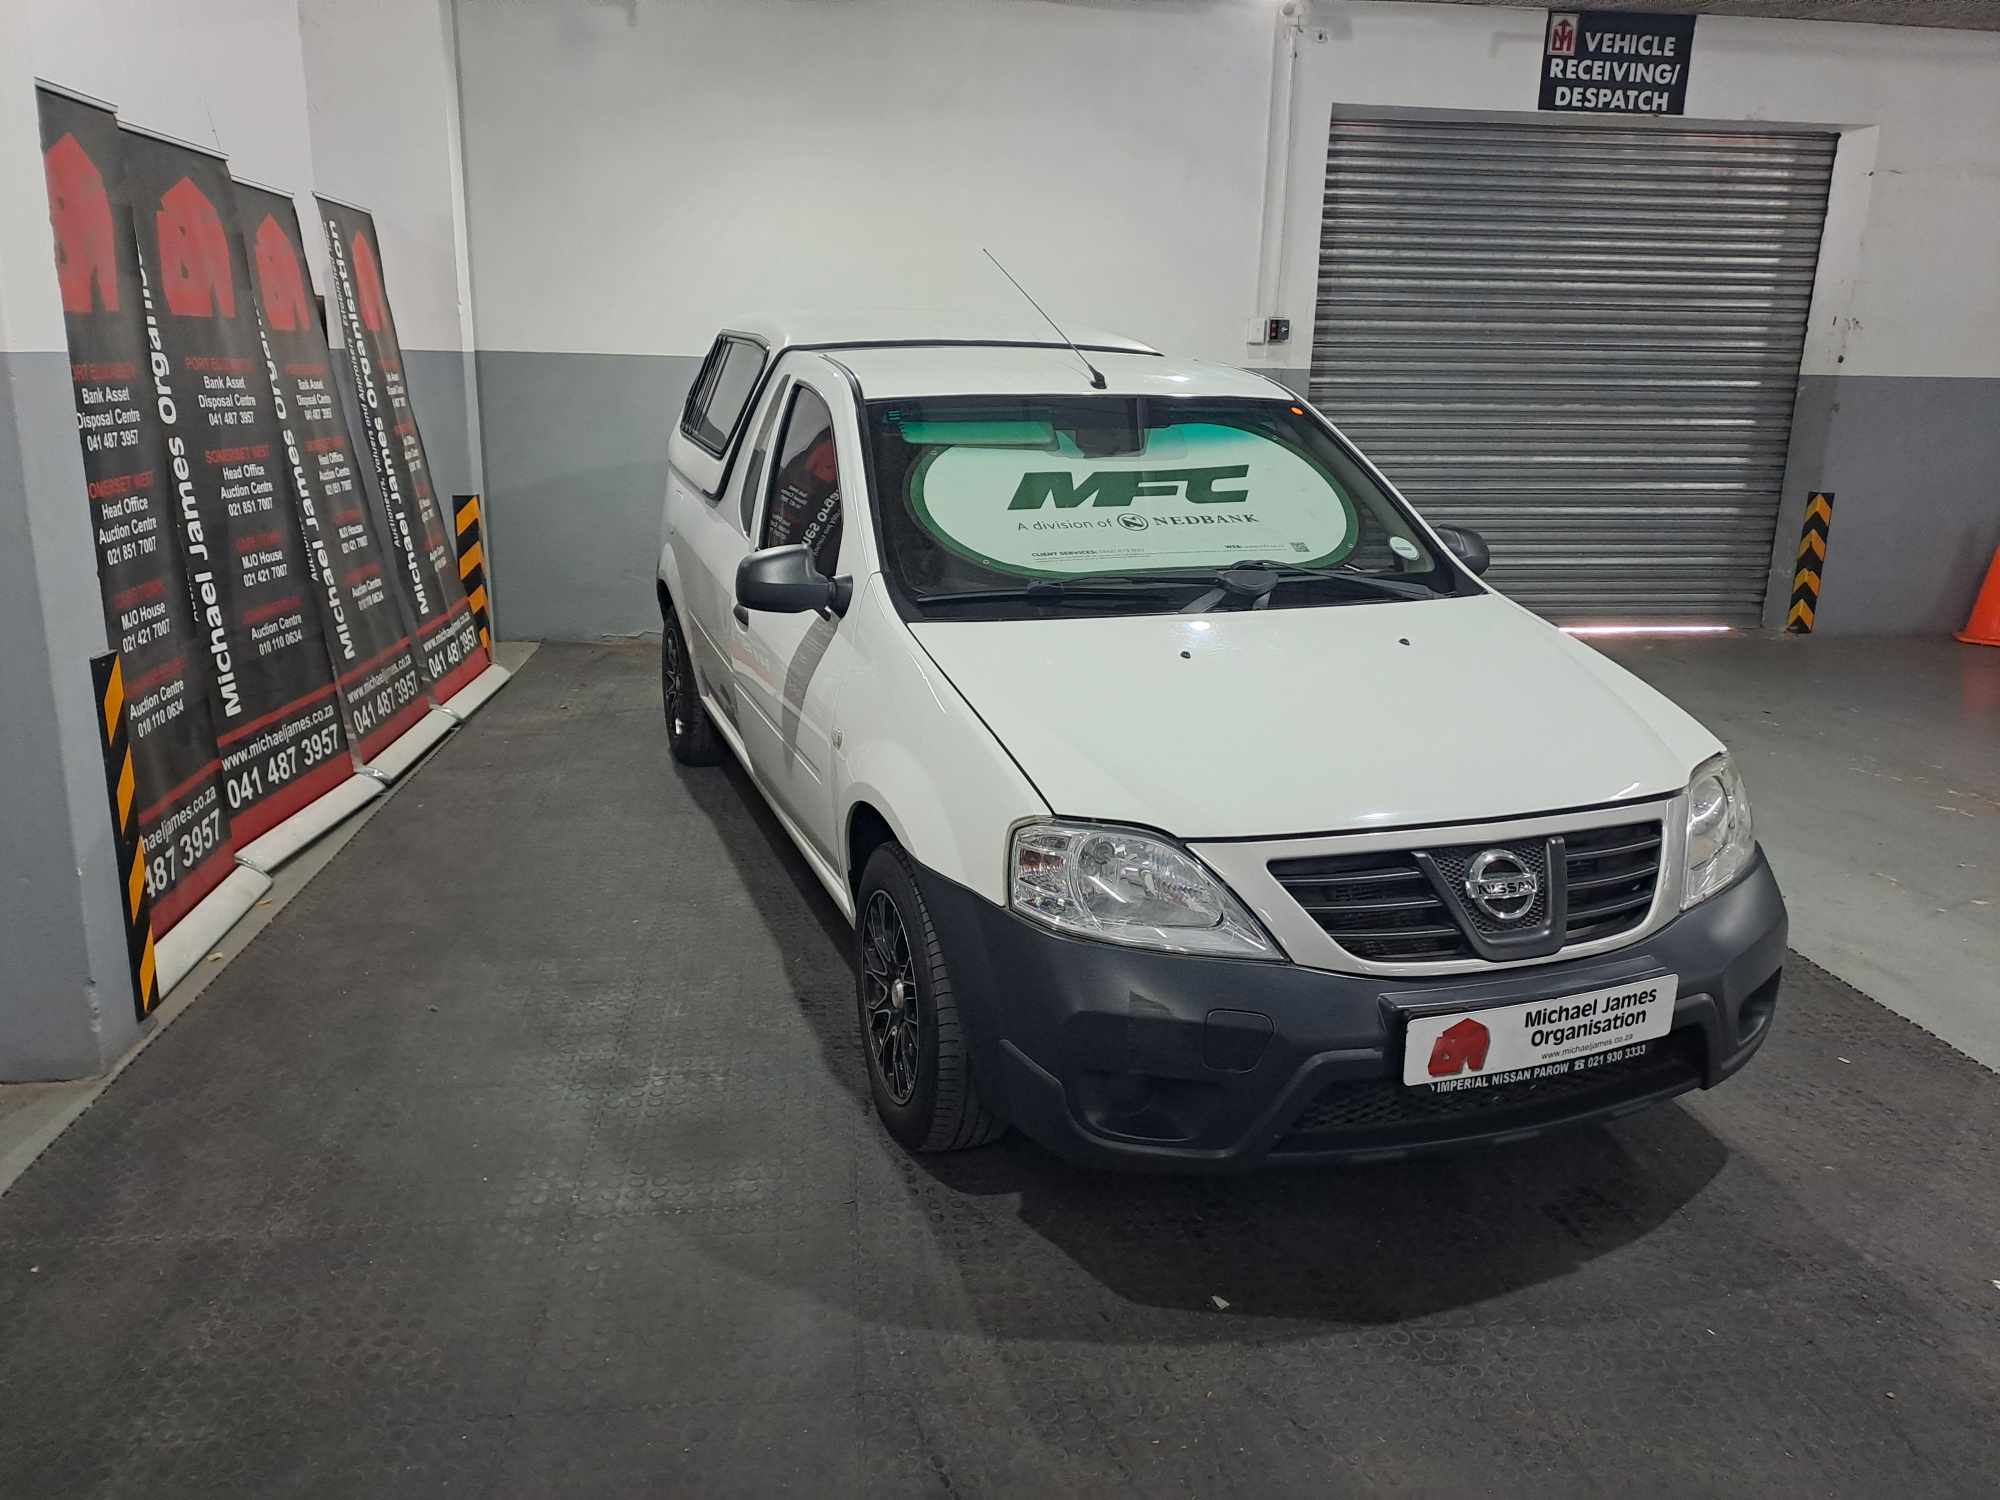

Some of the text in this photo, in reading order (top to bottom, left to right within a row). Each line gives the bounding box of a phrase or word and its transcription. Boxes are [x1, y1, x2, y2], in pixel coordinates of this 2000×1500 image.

[1585, 32, 1676, 57] VEHICLE
[1550, 58, 1681, 85] RECEIVING/
[1555, 86, 1669, 111] DESPATCH
[328, 219, 378, 410] Organisation
[81, 386, 130, 405] Bank Asset
[203, 375, 225, 390] Bank
[198, 393, 233, 411] Disposal
[76, 407, 141, 431] Disposal Centre
[208, 412, 224, 426] 041
[223, 411, 238, 425] 487
[86, 429, 139, 452] 041 487 3957
[222, 463, 265, 481] Head Office
[374, 416, 402, 504] James
[221, 480, 274, 500] Auction Centre
[282, 429, 320, 532] James
[1008, 464, 1249, 510] MFC
[101, 496, 148, 520] Head Office
[169, 436, 210, 562] James
[228, 502, 243, 517] 021
[242, 499, 257, 514] 851
[99, 516, 157, 545] Auction Centre
[1017, 521, 1029, 532] A
[1033, 518, 1093, 531] division
[1098, 517, 1112, 529] of
[1152, 512, 1259, 527] NEDBANK
[107, 535, 157, 566] 021 851 7007
[241, 550, 283, 570] MJO House
[395, 511, 430, 616] Michael
[243, 563, 288, 588] 021 421 7007
[310, 538, 356, 662] Michael
[121, 601, 166, 631] MJO House
[251, 614, 303, 641] Auction Centre
[122, 618, 170, 653] 021 421 7007
[193, 571, 242, 718] Michael
[272, 635, 286, 651] 110
[428, 650, 447, 678] 041
[129, 679, 185, 720] Auction Centre
[353, 670, 418, 734] 041 487 3957
[137, 698, 185, 738] 010 110 0634
[221, 704, 335, 772] www.michaeljames.co.za
[226, 723, 338, 809] 041 487 3957
[145, 807, 220, 899] 487 3957
[1477, 880, 1535, 896] NISSAN
[1525, 988, 1657, 1028] Michael James
[1530, 1009, 1647, 1047] Organisation
[1541, 1034, 1633, 1060] www.michaeljames.co.za
[1437, 1045, 1646, 1093] IMPERIAL NISSAN PAROW 021 930 3333
